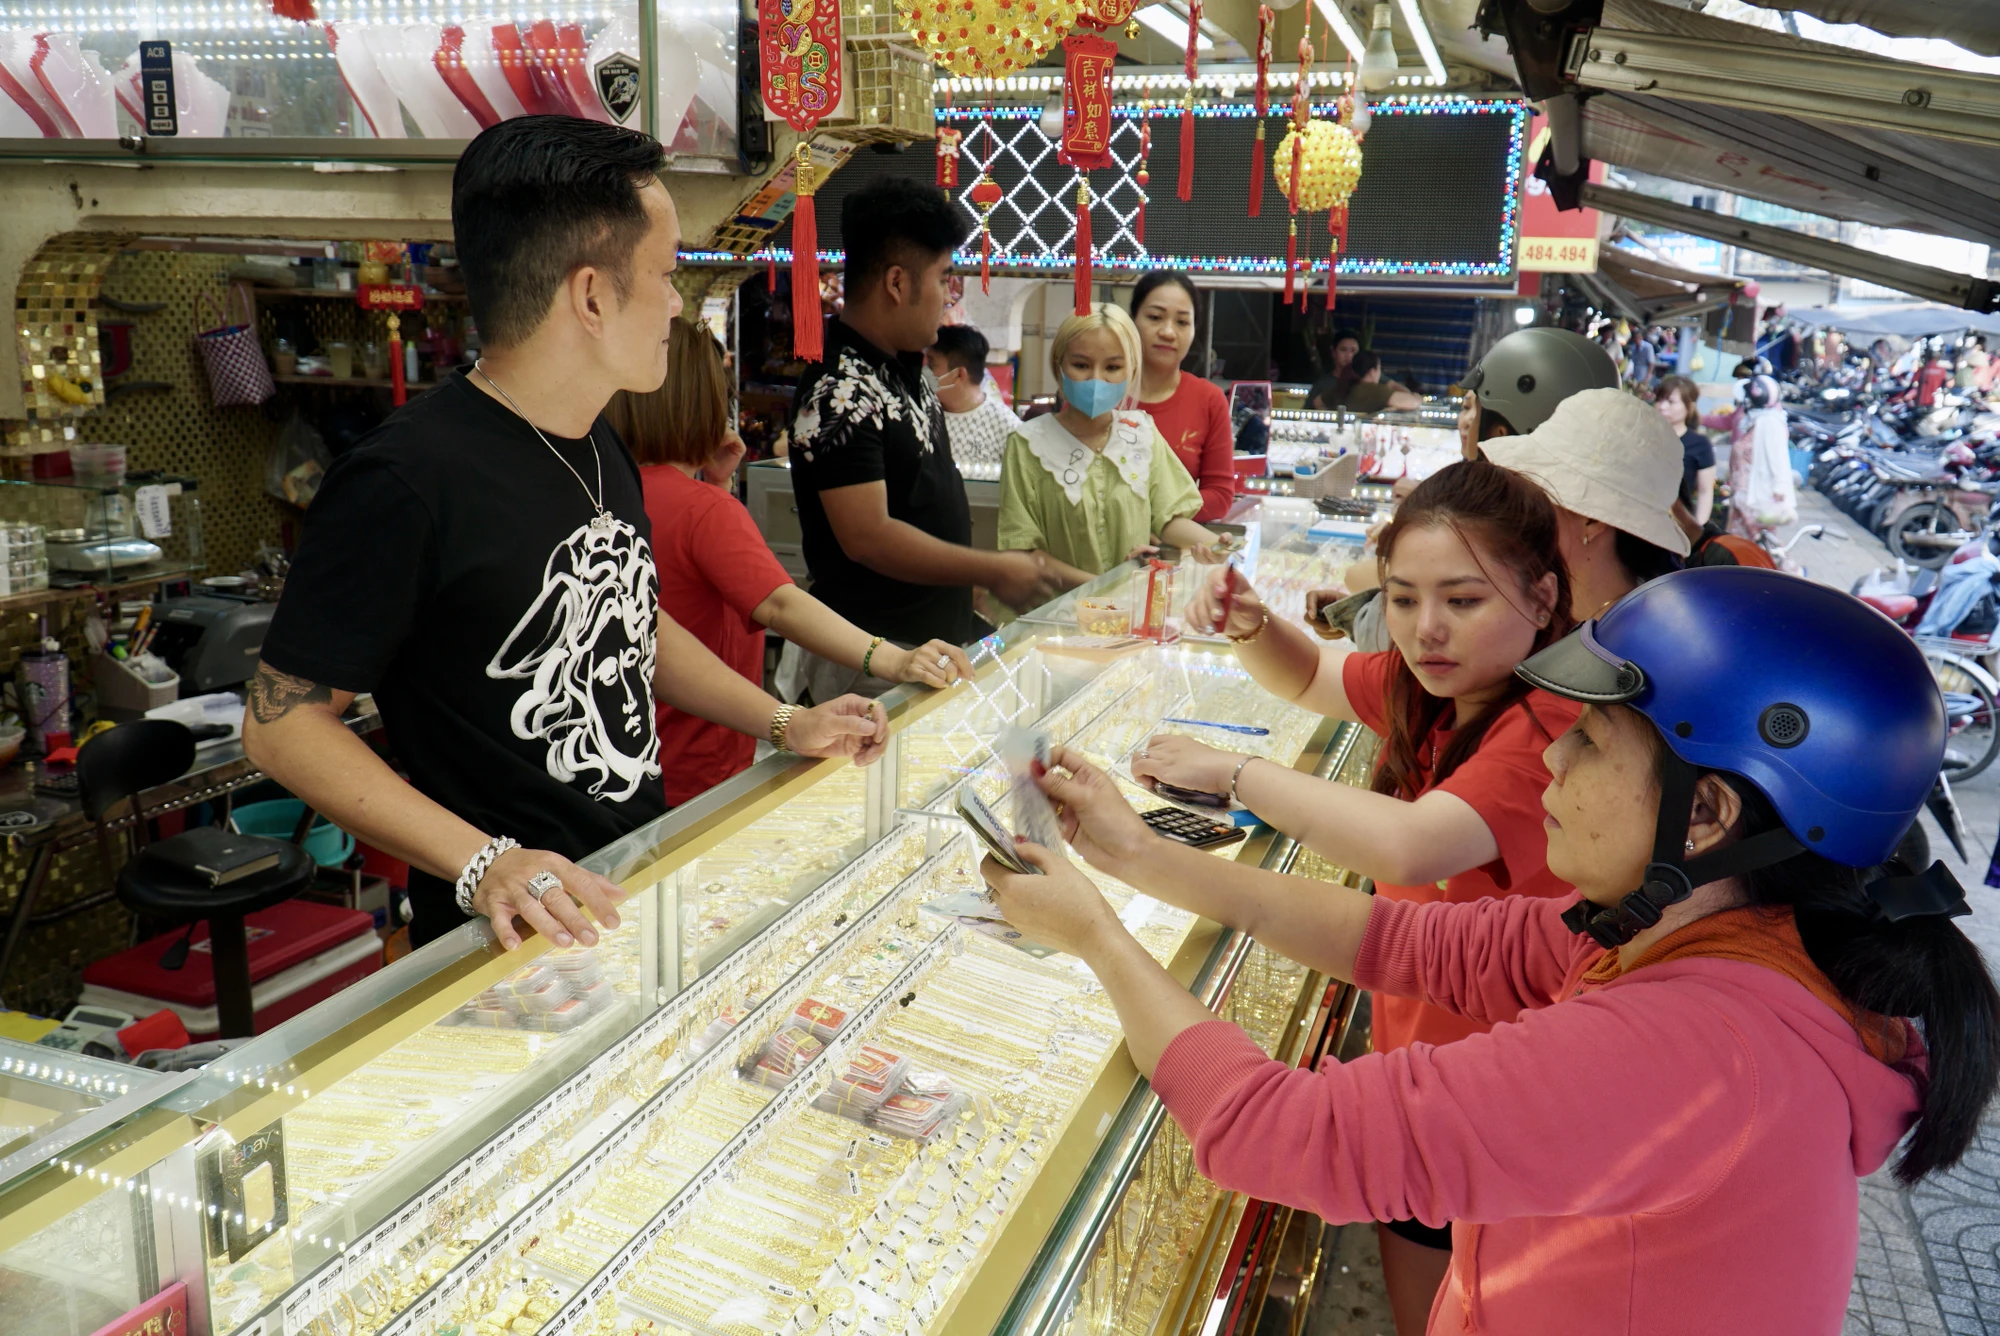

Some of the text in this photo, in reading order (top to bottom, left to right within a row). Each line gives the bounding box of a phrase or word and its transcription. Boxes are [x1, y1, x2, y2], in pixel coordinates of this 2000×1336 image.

[146, 47, 165, 58] ACB
[1082, 58, 1103, 140] 吉祥如意
[232, 1128, 275, 1167] ebay
